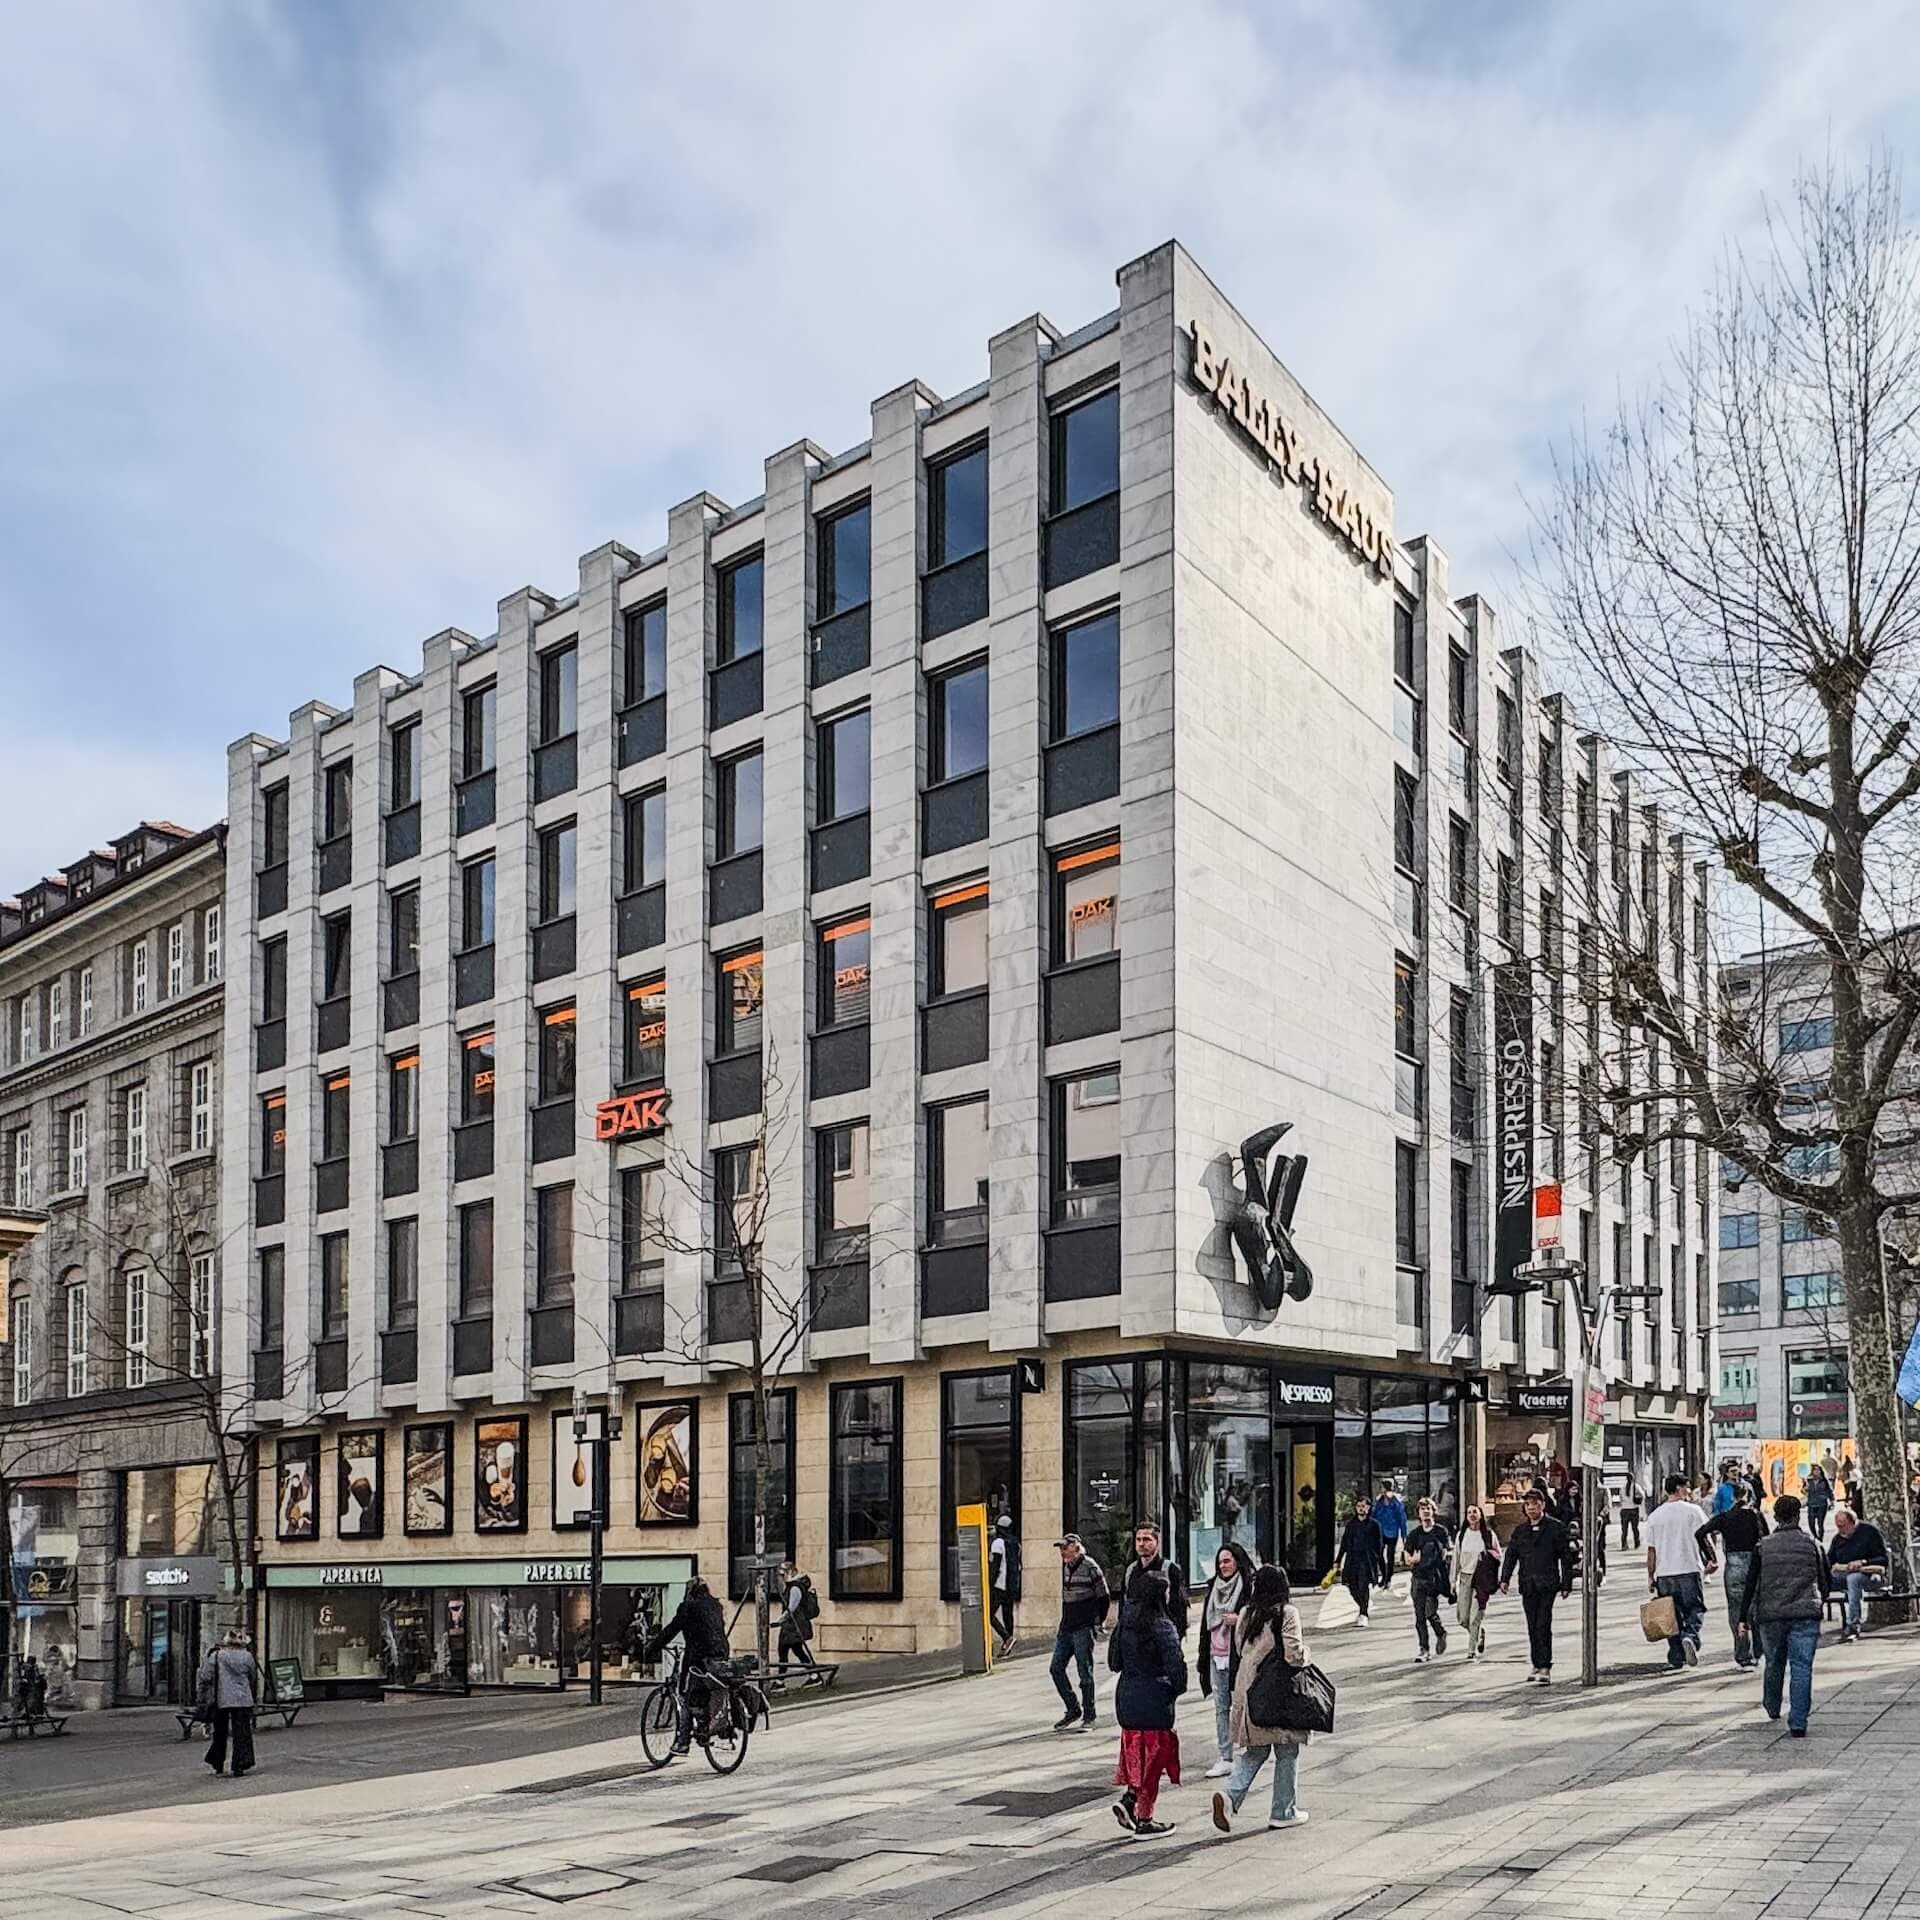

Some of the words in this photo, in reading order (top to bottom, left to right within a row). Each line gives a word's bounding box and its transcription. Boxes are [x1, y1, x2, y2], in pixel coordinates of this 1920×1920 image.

[1072, 897, 1110, 920] DAK
[836, 964, 868, 986] DAK
[596, 1088, 668, 1140] DAK
[1500, 1038, 1531, 1216] NESPRESSO
[1279, 1380, 1333, 1405] NESPRESSO
[1519, 1393, 1569, 1409] Kraemer
[320, 1567, 352, 1583] PAPER
[525, 1564, 563, 1581] PAPER
